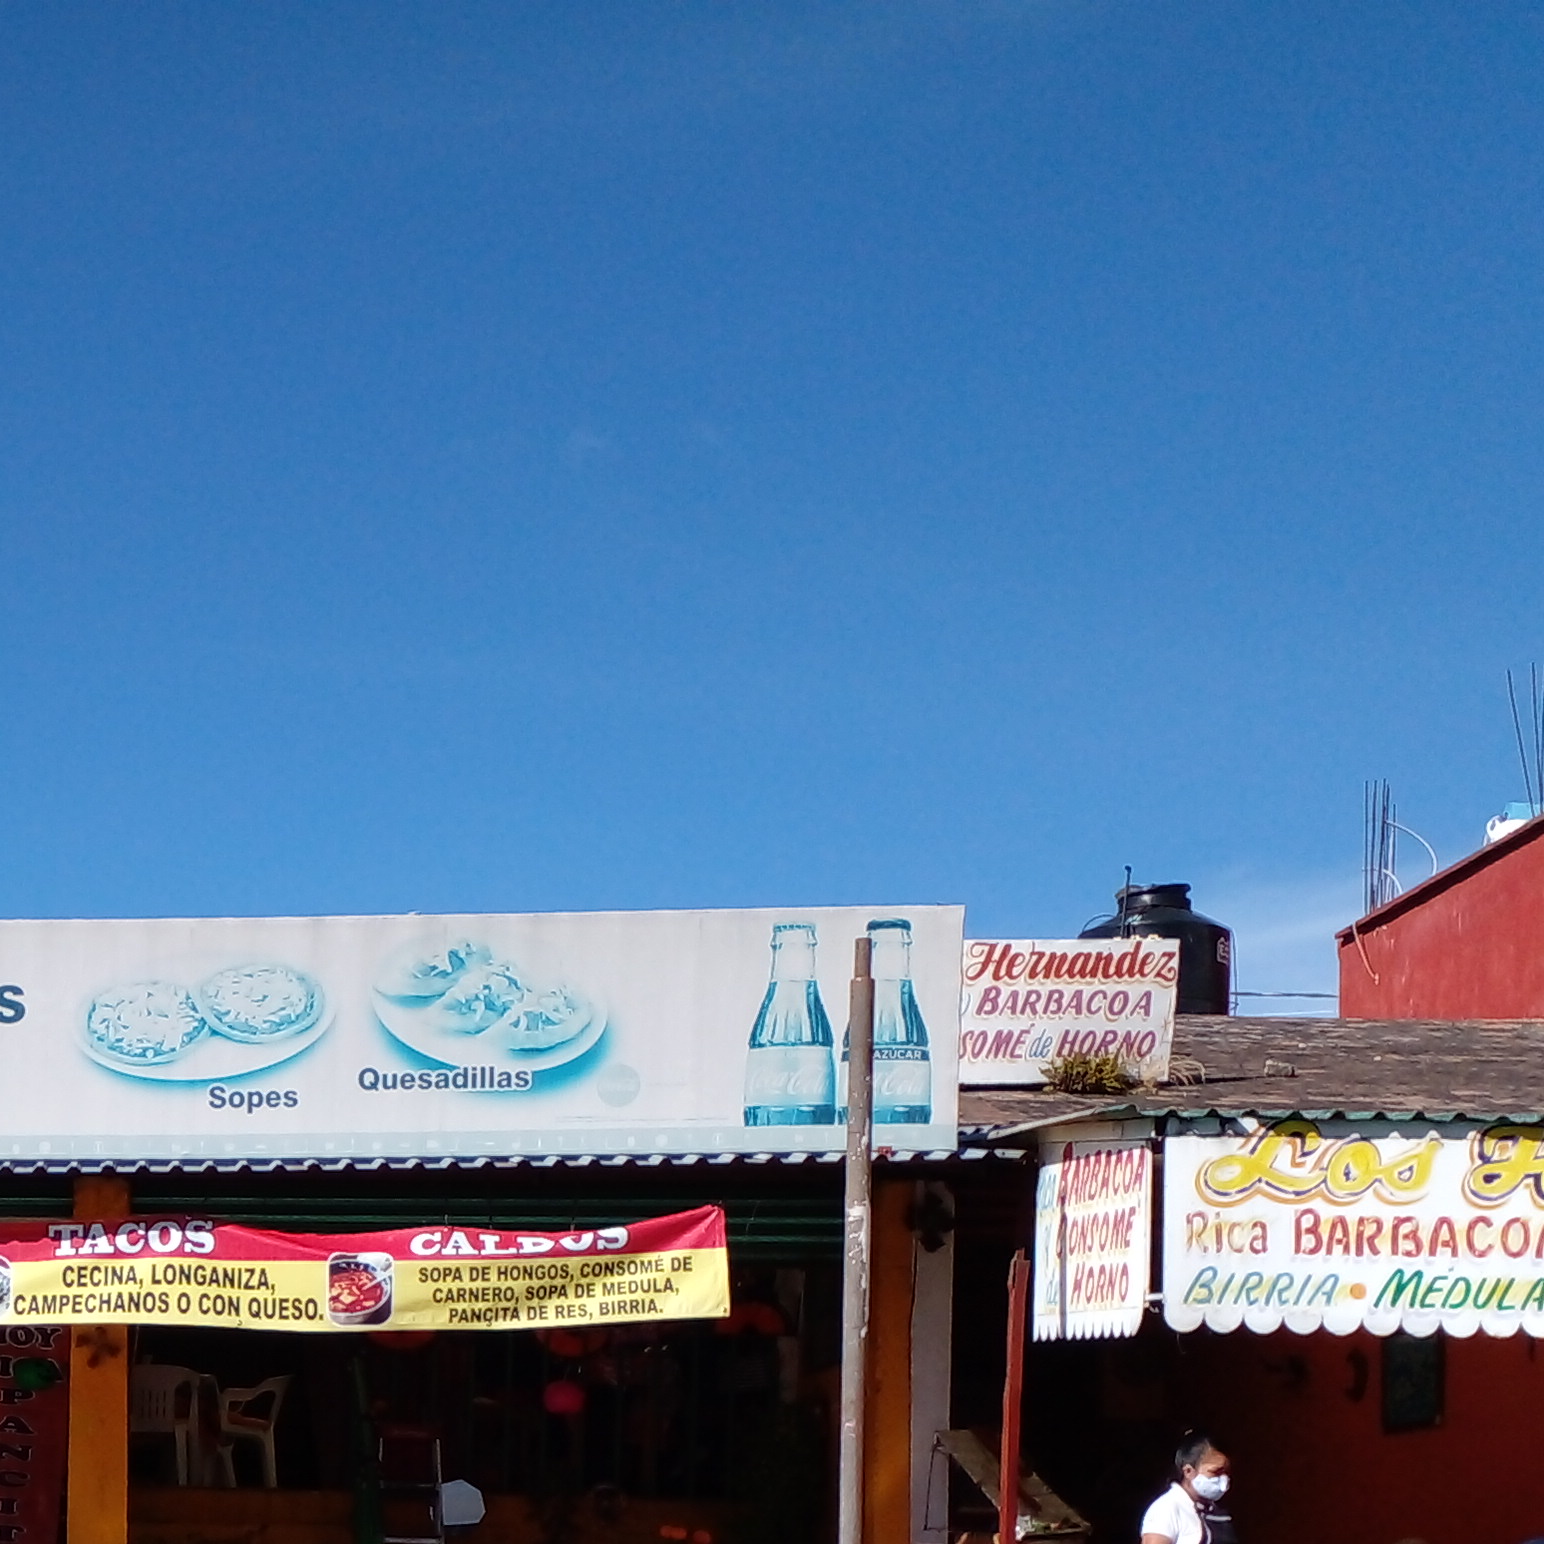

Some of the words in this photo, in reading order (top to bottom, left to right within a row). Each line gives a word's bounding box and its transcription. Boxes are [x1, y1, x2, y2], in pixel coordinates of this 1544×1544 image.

[975, 986, 1153, 1018] BARBACOA
[1028, 1028, 1053, 1059] de
[1055, 1029, 1157, 1060] HORNO
[357, 1068, 530, 1092] Quesadillas
[209, 1087, 299, 1113] Sopes
[1057, 1141, 1146, 1207] BARBACOA
[47, 1218, 216, 1257] TACOS
[1185, 1209, 1269, 1254] Rica
[61, 1264, 144, 1290] CECINA,
[150, 1263, 277, 1296] LONGANIZA,
[418, 1266, 464, 1284] SOPA
[469, 1265, 491, 1283] DE
[497, 1262, 575, 1283] HONGOS,
[580, 1255, 663, 1277] CONSOMÉ
[671, 1255, 693, 1273] DE
[1070, 1261, 1130, 1305] HORNO
[432, 1286, 521, 1306] CARNERO,
[525, 1283, 568, 1301] SOPA
[574, 1281, 596, 1299] DE
[602, 1277, 680, 1297] MEDULA,
[1183, 1265, 1340, 1307] BIRRIA
[13, 1291, 170, 1317] CAMPECHANOS
[176, 1292, 191, 1313] O
[198, 1292, 241, 1317] CON
[247, 1298, 325, 1322] QUESO.
[526, 1303, 549, 1321] DE
[555, 1302, 593, 1320] RES,
[599, 1296, 664, 1316] BIRRIA.
